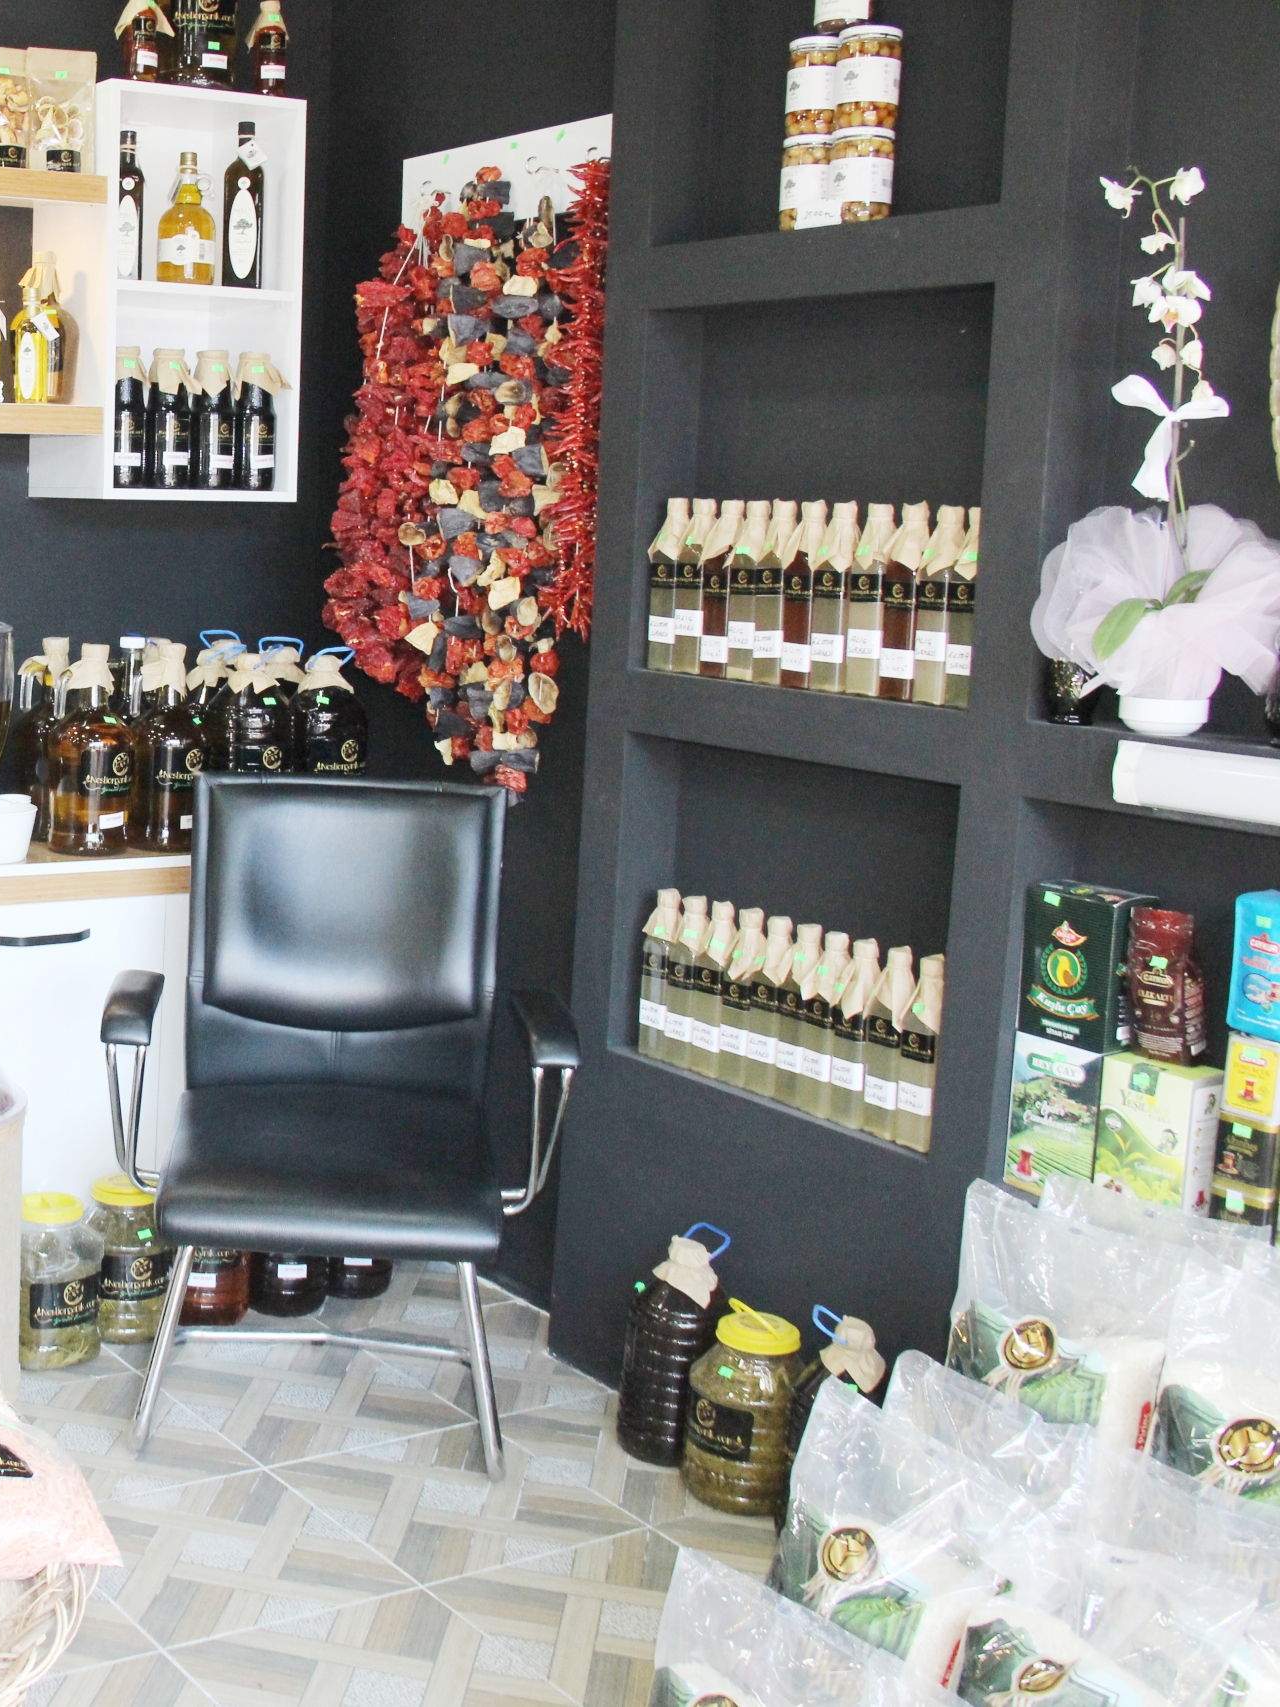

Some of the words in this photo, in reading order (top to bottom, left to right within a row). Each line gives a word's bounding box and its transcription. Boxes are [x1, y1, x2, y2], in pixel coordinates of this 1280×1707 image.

[1036, 992, 1066, 1013] Kuşlu
[1066, 1002, 1088, 1016] Çay
[1032, 1056, 1053, 1071] BEY
